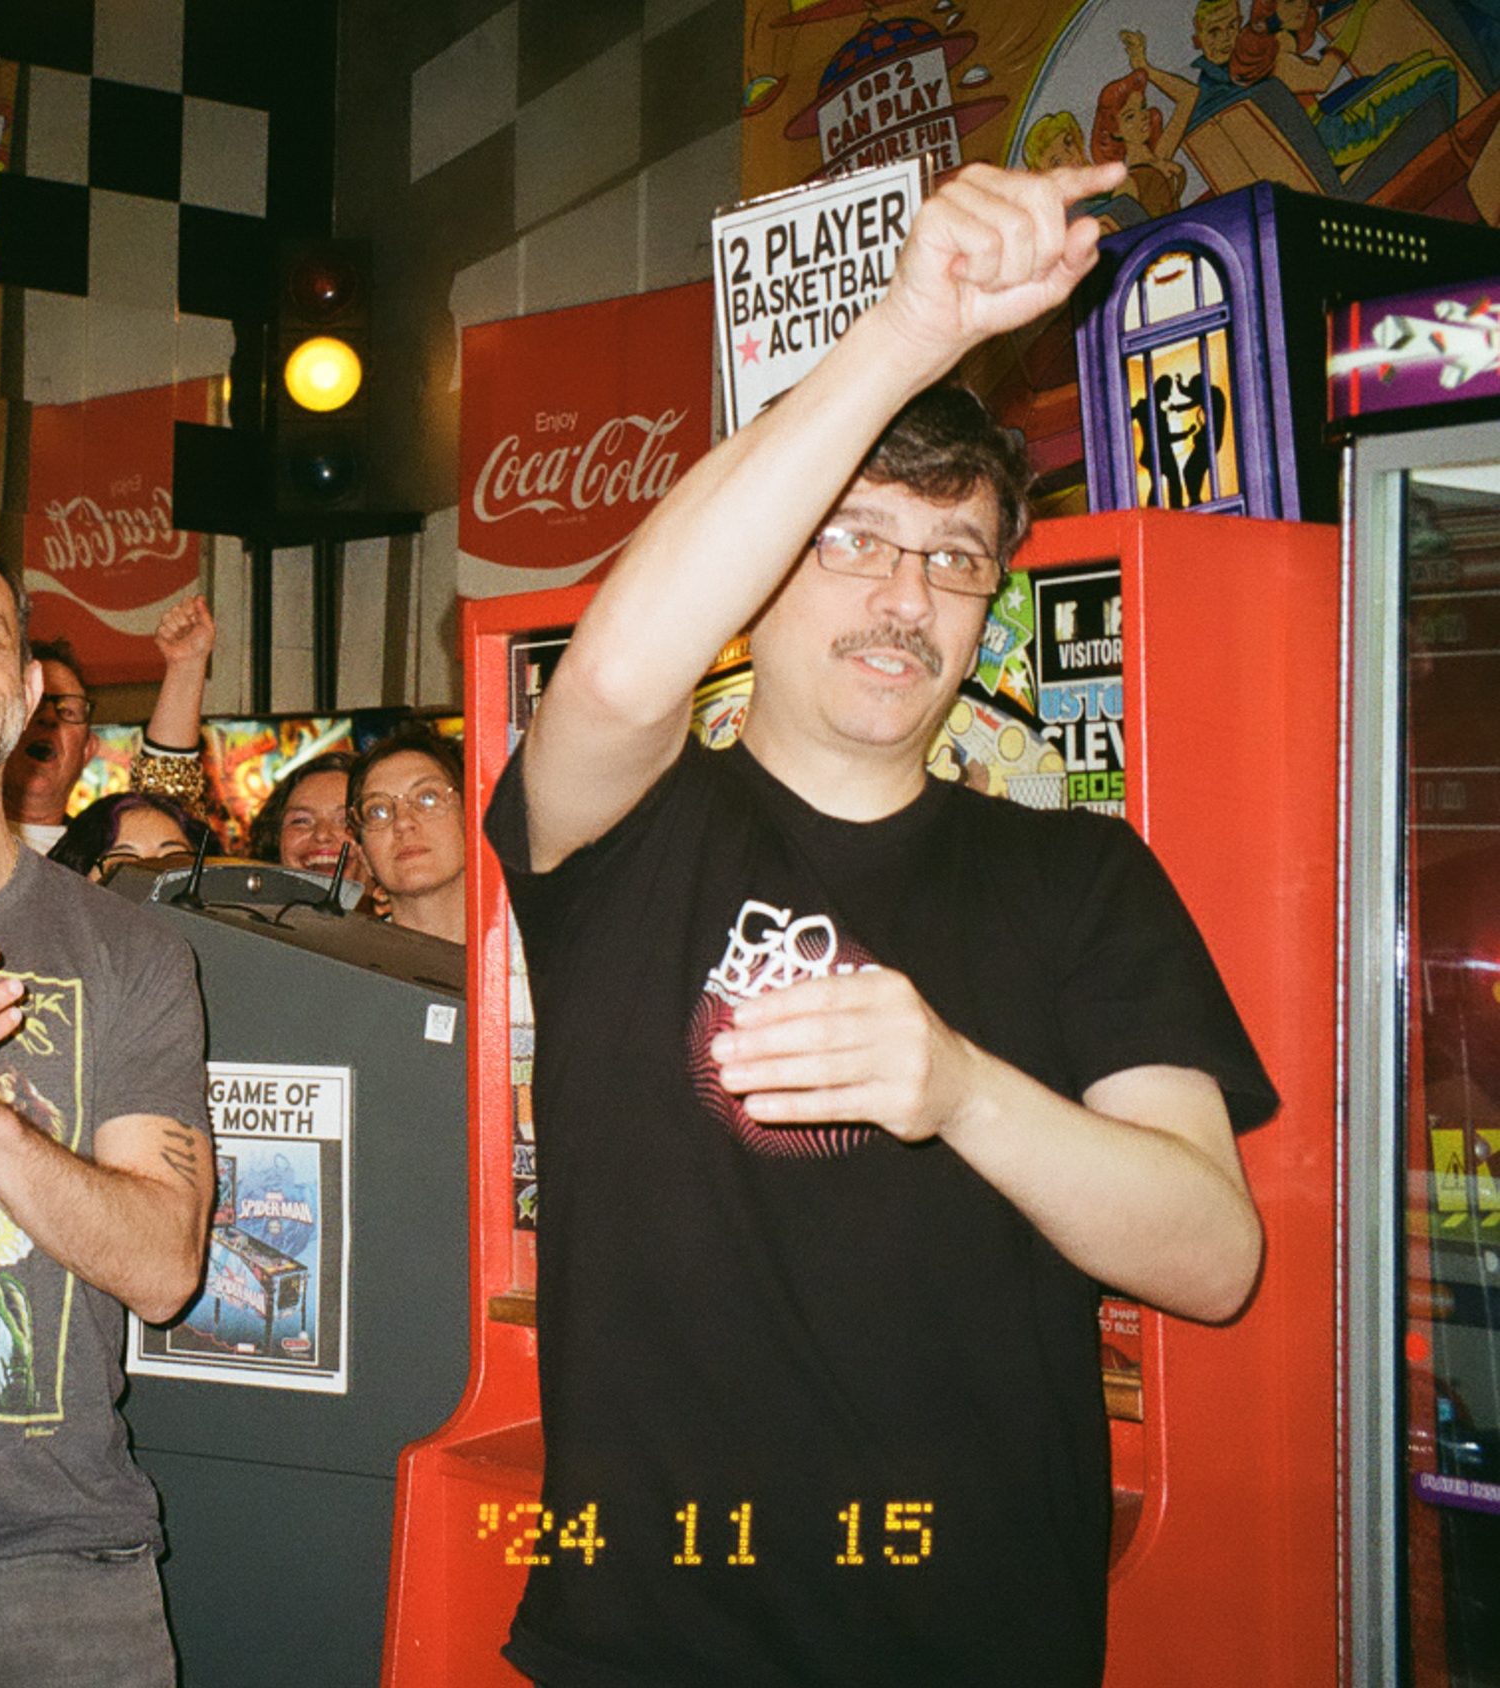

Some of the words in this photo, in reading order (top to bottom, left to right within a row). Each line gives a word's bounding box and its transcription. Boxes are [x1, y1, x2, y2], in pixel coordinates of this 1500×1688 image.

[857, 72, 891, 101] OR
[894, 60, 915, 90] 2
[827, 108, 872, 157] CAN
[877, 79, 943, 127] PLAY
[856, 132, 911, 168] MORE
[915, 119, 950, 150] FUN
[730, 236, 751, 286] 2
[765, 190, 907, 275] PLAYER
[732, 245, 900, 326] BASKETBAL
[534, 410, 579, 433] Enjoy
[473, 408, 688, 524] Coca-Cola
[735, 899, 837, 970] GO
[209, 1080, 278, 1106] GAME
[285, 1083, 321, 1107] OF
[223, 1107, 314, 1135] MONTH
